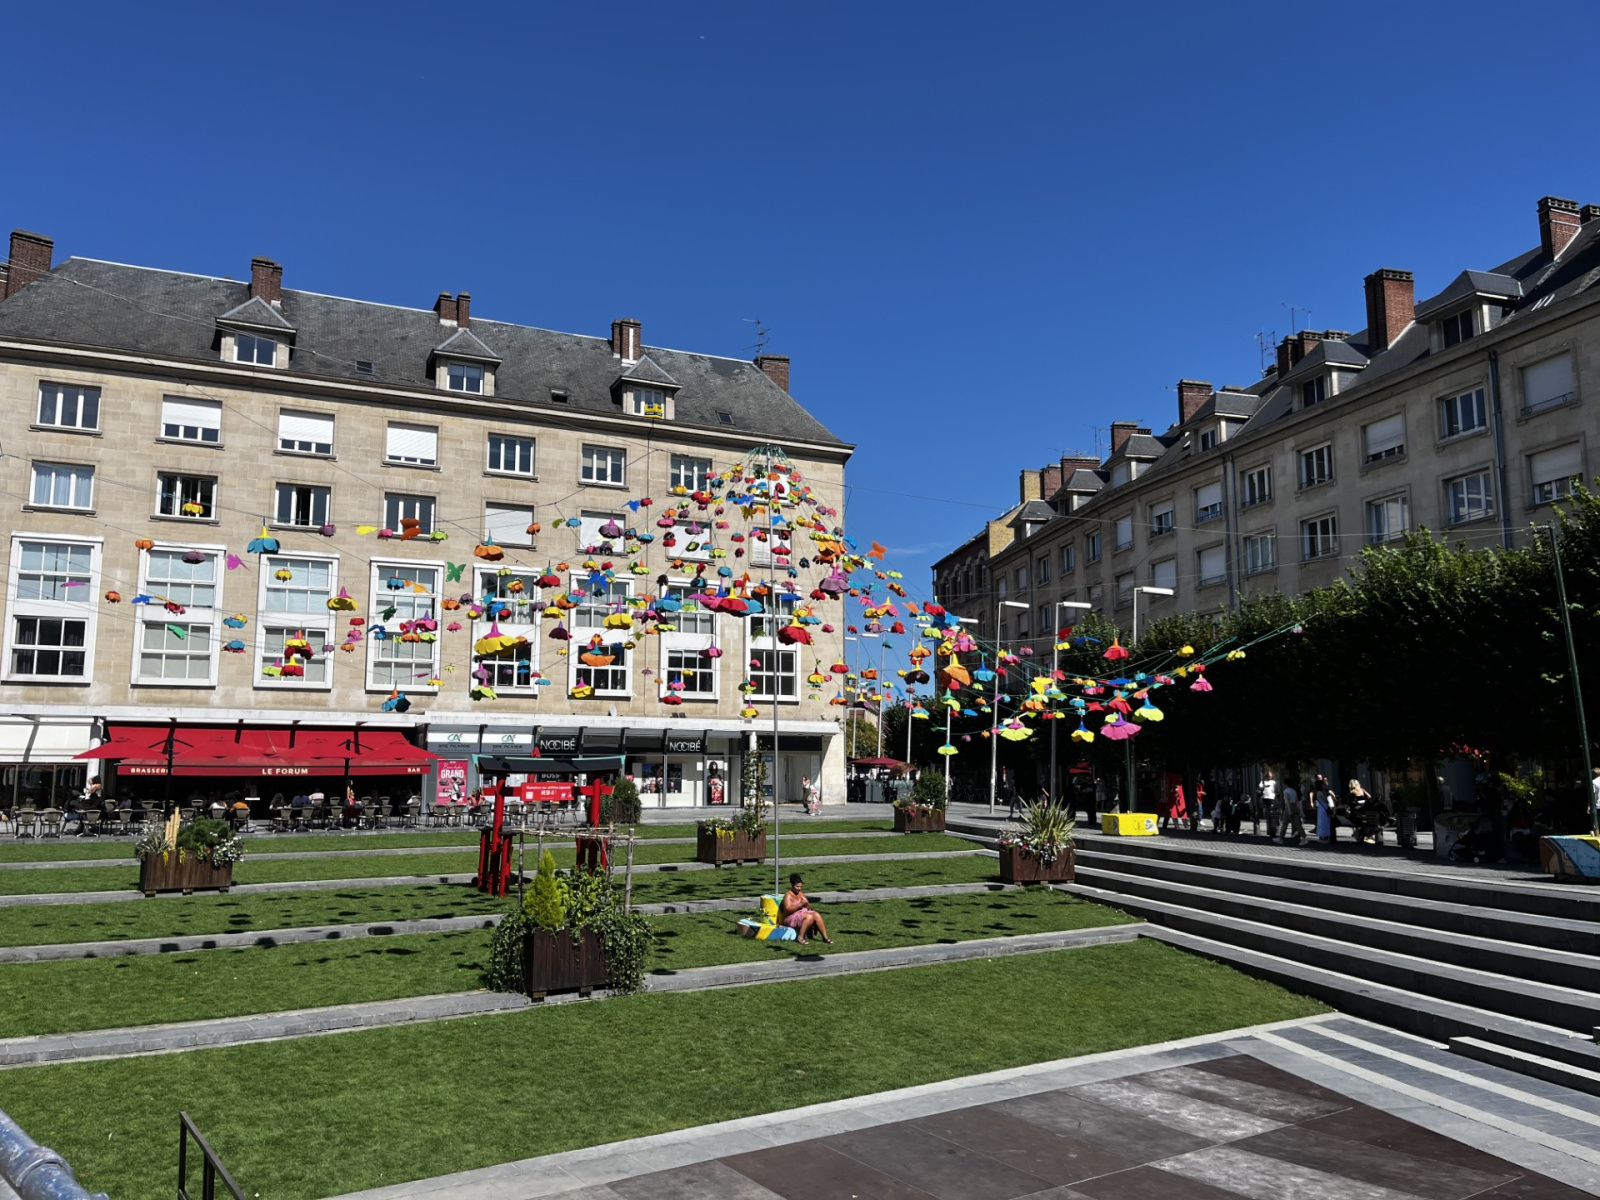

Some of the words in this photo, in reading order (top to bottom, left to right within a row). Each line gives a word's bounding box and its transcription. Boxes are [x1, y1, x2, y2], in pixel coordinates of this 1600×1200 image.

[540, 737, 576, 750] NOCIBÉ
[669, 739, 701, 752] NOCIBÉ
[440, 769, 464, 779] GRAND
